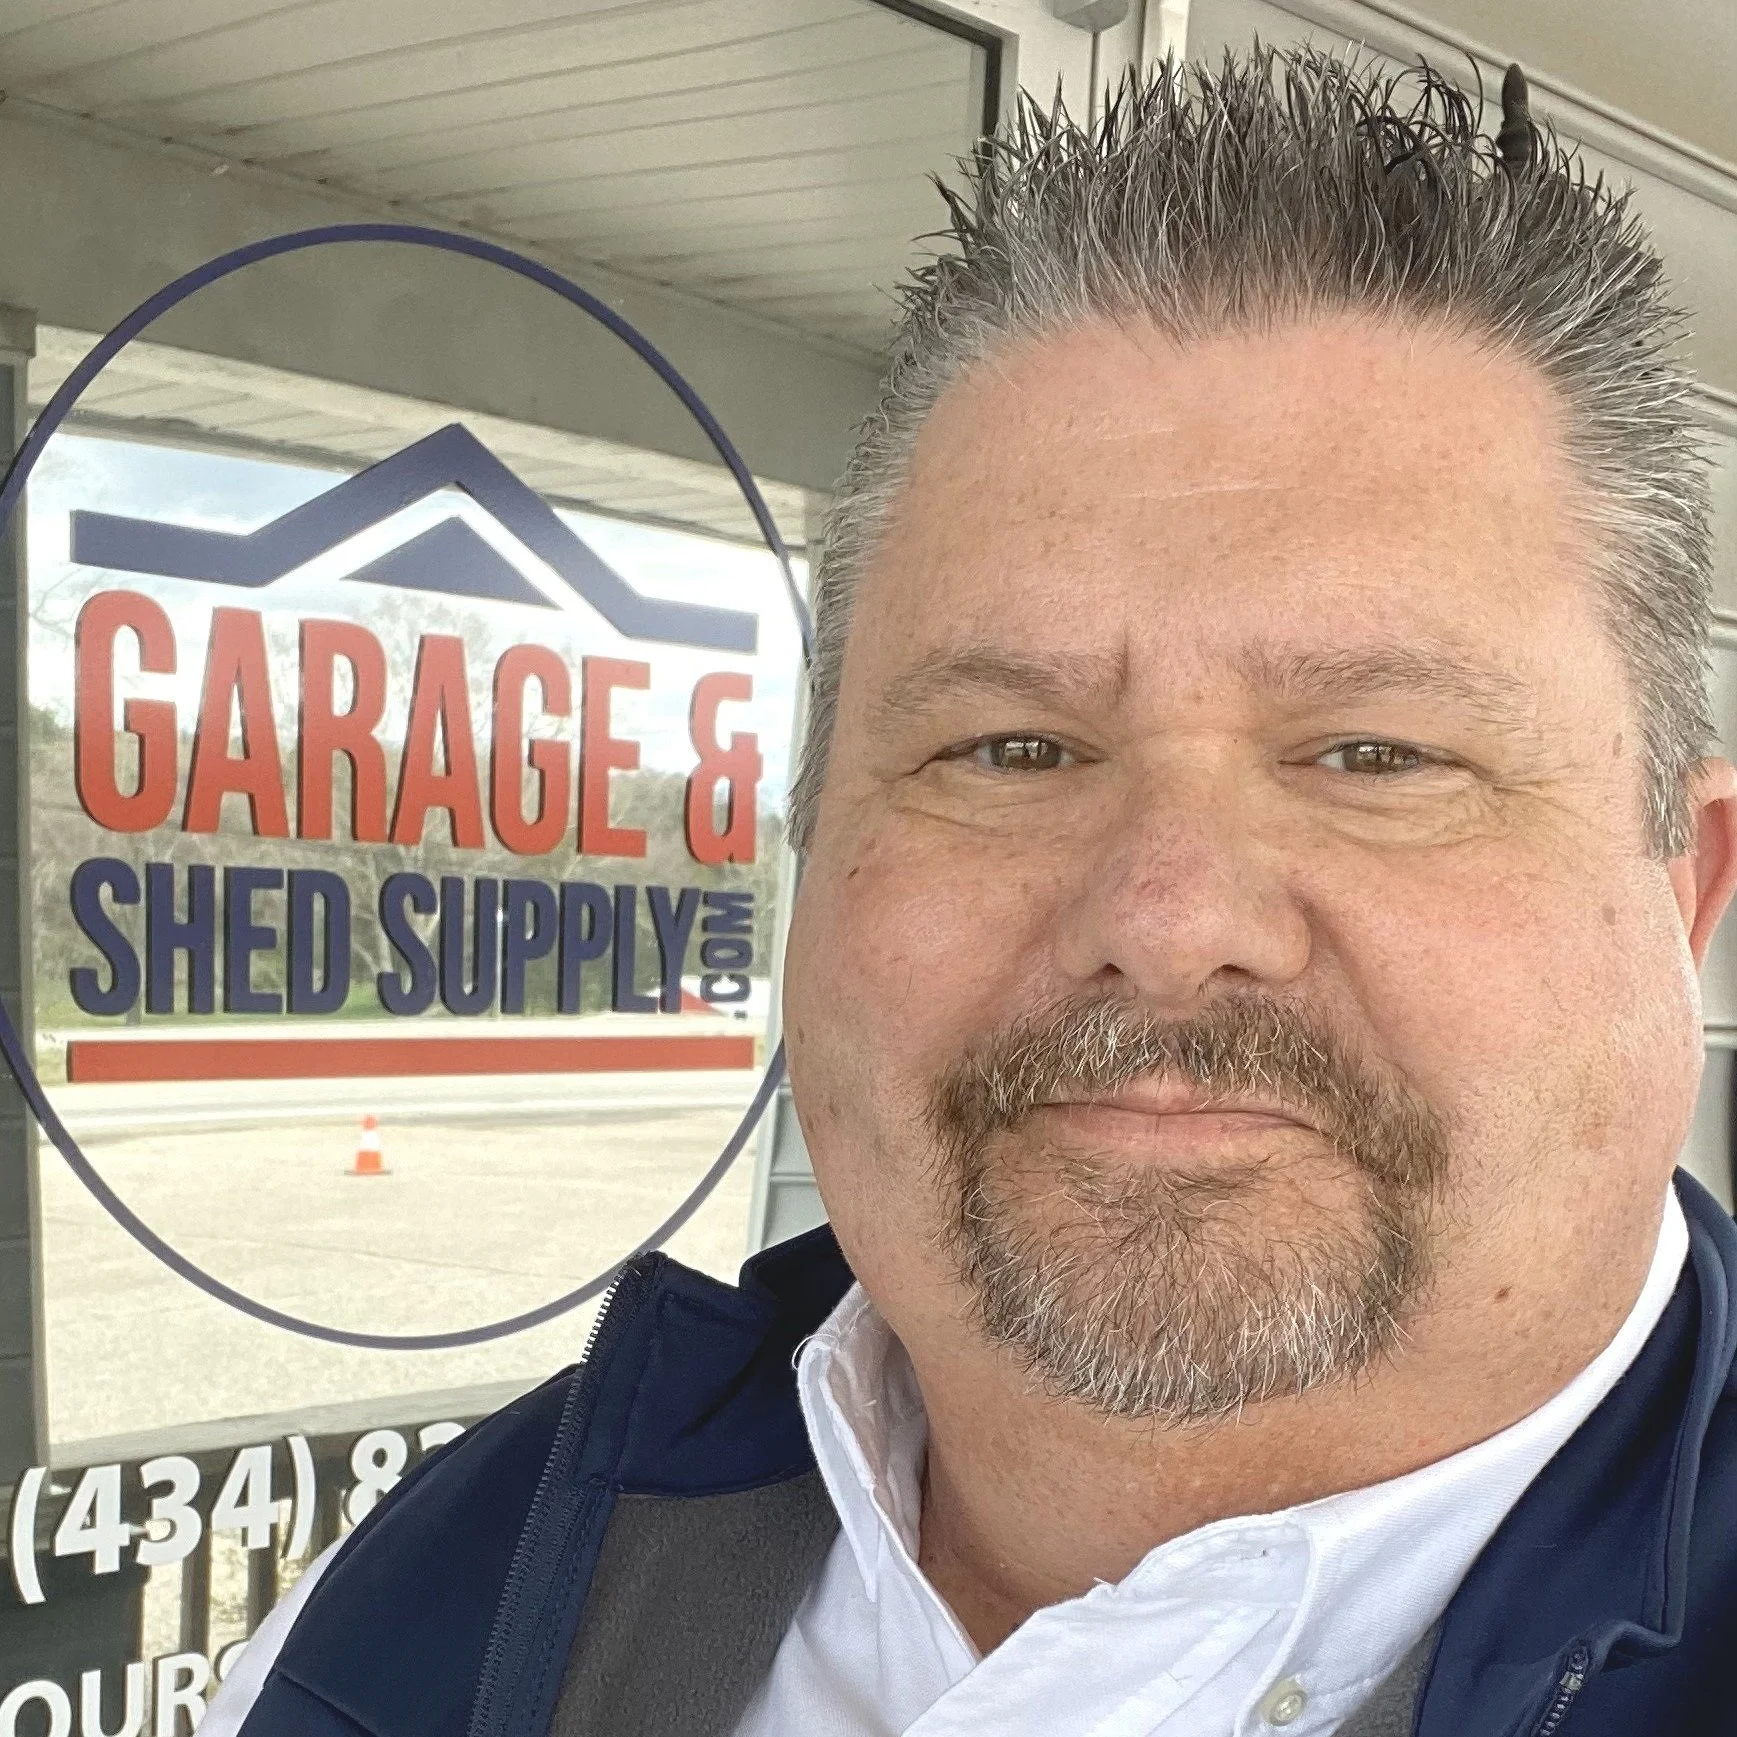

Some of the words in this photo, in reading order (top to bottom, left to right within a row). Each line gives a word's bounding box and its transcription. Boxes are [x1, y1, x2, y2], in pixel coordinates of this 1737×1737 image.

[75, 590, 651, 858] GARAGE
[686, 672, 763, 865] &
[69, 858, 351, 1016] SHED
[377, 871, 702, 1016] SUPPLY
[701, 891, 755, 1020] .COM
[11, 1434, 316, 1604] (434)
[344, 1422, 466, 1526] 8
[0, 1640, 249, 1737] OUR
